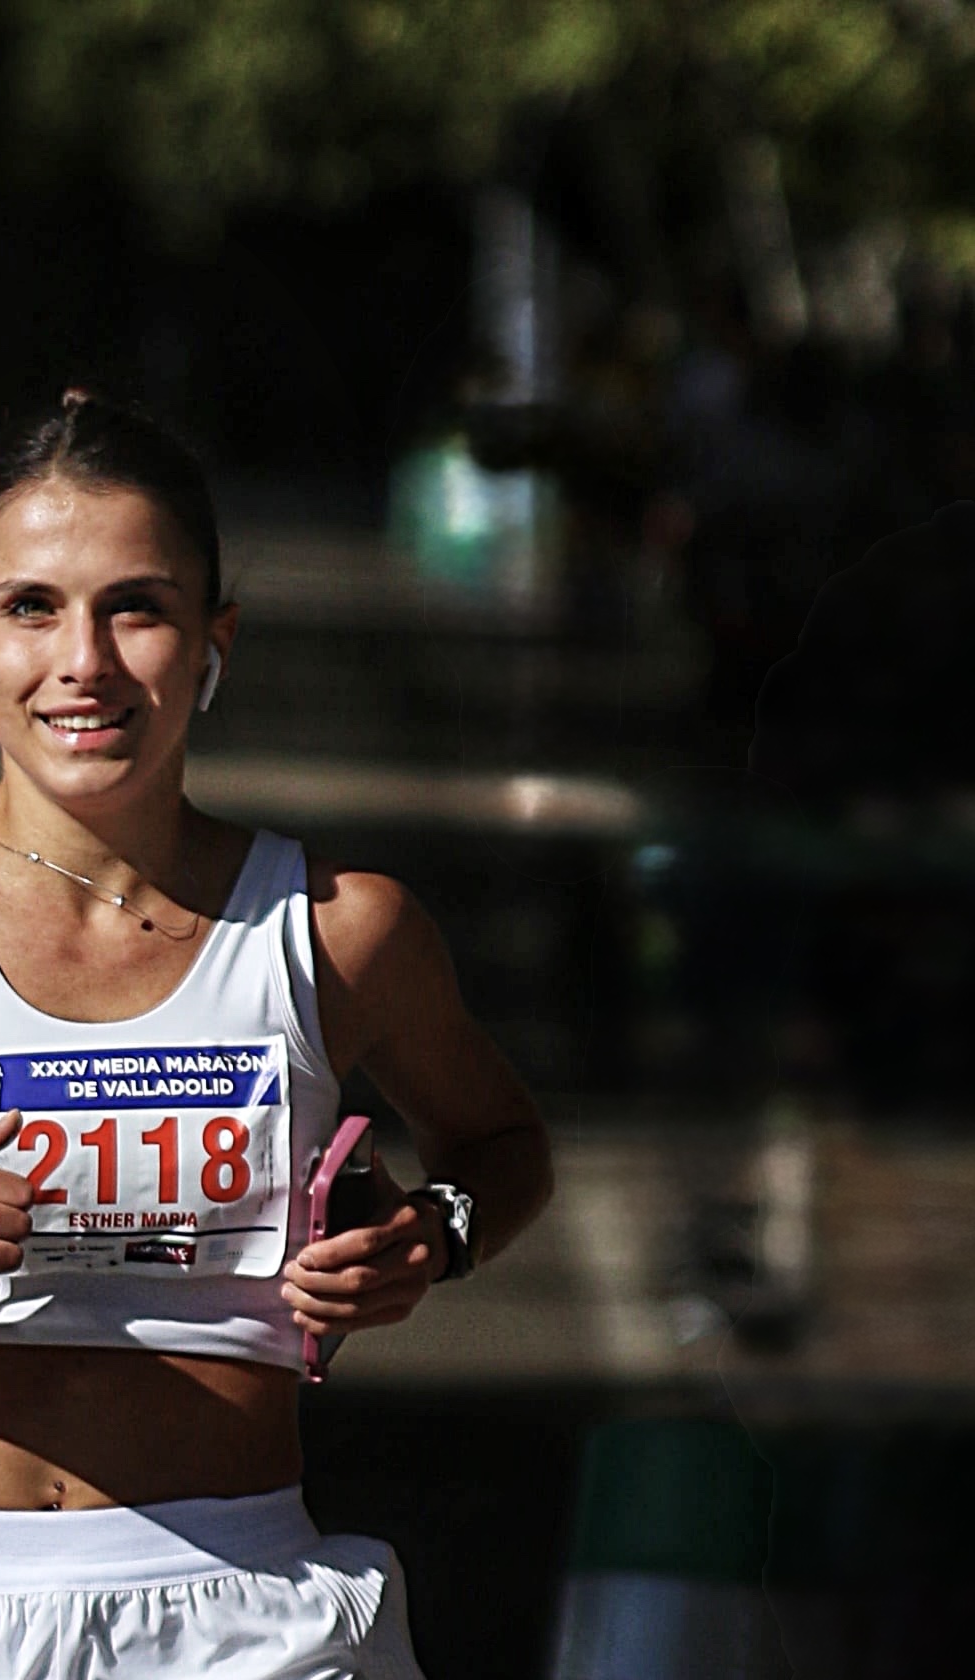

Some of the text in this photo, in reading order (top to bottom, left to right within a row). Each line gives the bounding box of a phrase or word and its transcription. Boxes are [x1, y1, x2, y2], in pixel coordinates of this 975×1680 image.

[31, 1060, 88, 1077] XXXV
[93, 1058, 161, 1075] MEDIA
[69, 1079, 234, 1098] DE VALLADOLID
[18, 1116, 251, 1205] 2118
[69, 1212, 198, 1228] ESTHER MARIA
